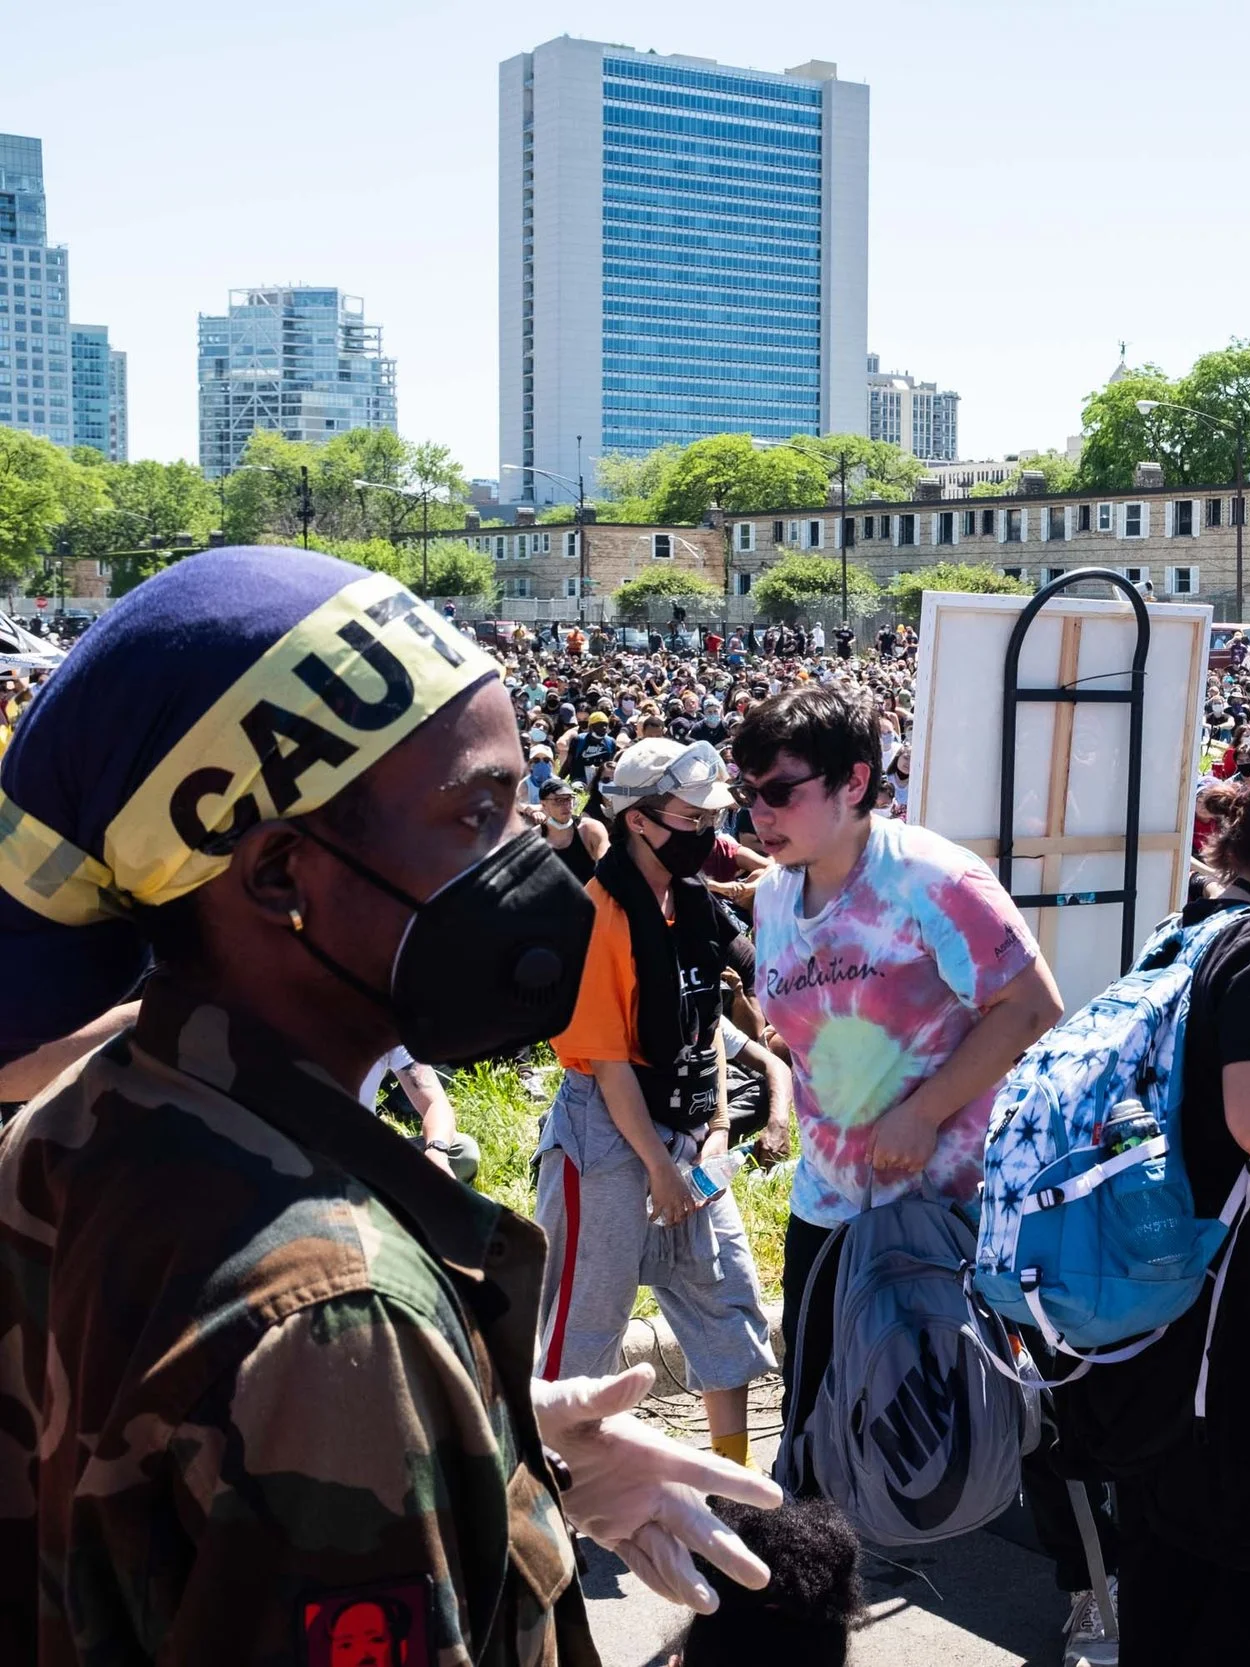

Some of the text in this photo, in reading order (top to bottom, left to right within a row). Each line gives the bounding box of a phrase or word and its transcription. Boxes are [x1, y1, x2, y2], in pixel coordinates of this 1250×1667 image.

[767, 956, 885, 999] Revolution.
[688, 1088, 718, 1115] FIL
[869, 1335, 956, 1488] NIK
